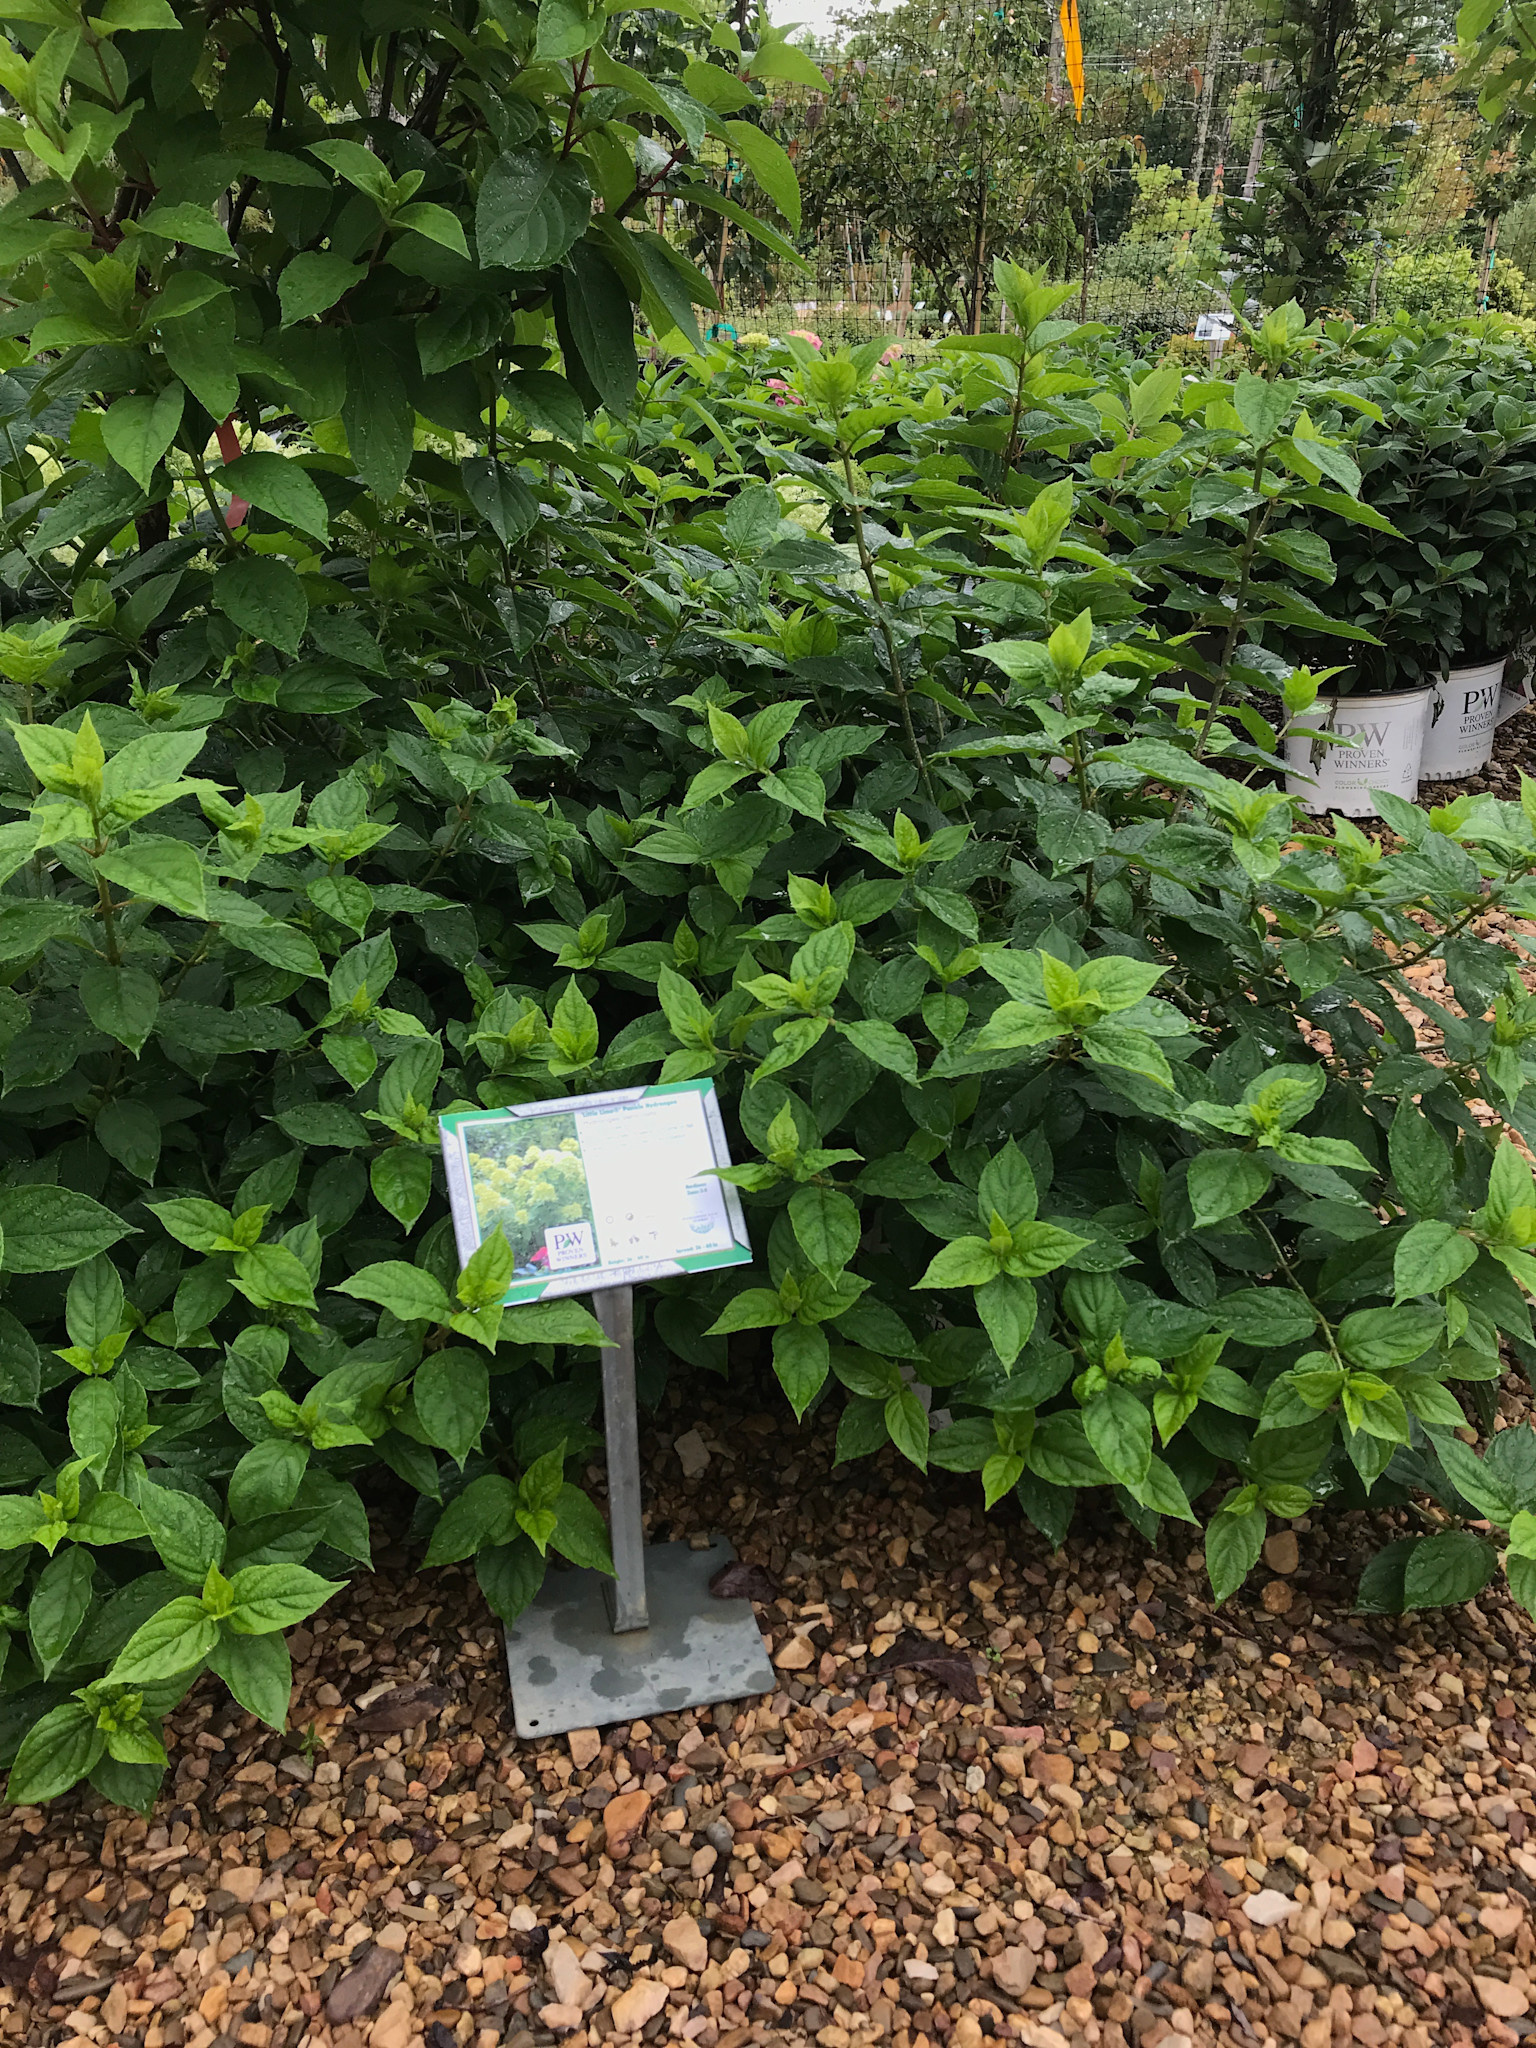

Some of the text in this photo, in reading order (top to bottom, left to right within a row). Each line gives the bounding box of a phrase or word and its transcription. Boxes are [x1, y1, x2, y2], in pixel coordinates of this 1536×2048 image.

[1461, 682, 1500, 715] PW
[1459, 717, 1494, 733] WINNERS
[1464, 710, 1493, 724] PROVEN
[1335, 721, 1392, 748] PW
[1339, 749, 1385, 759] PROVEN
[554, 1230, 584, 1250] PW
[557, 1247, 584, 1256] PROVEN
